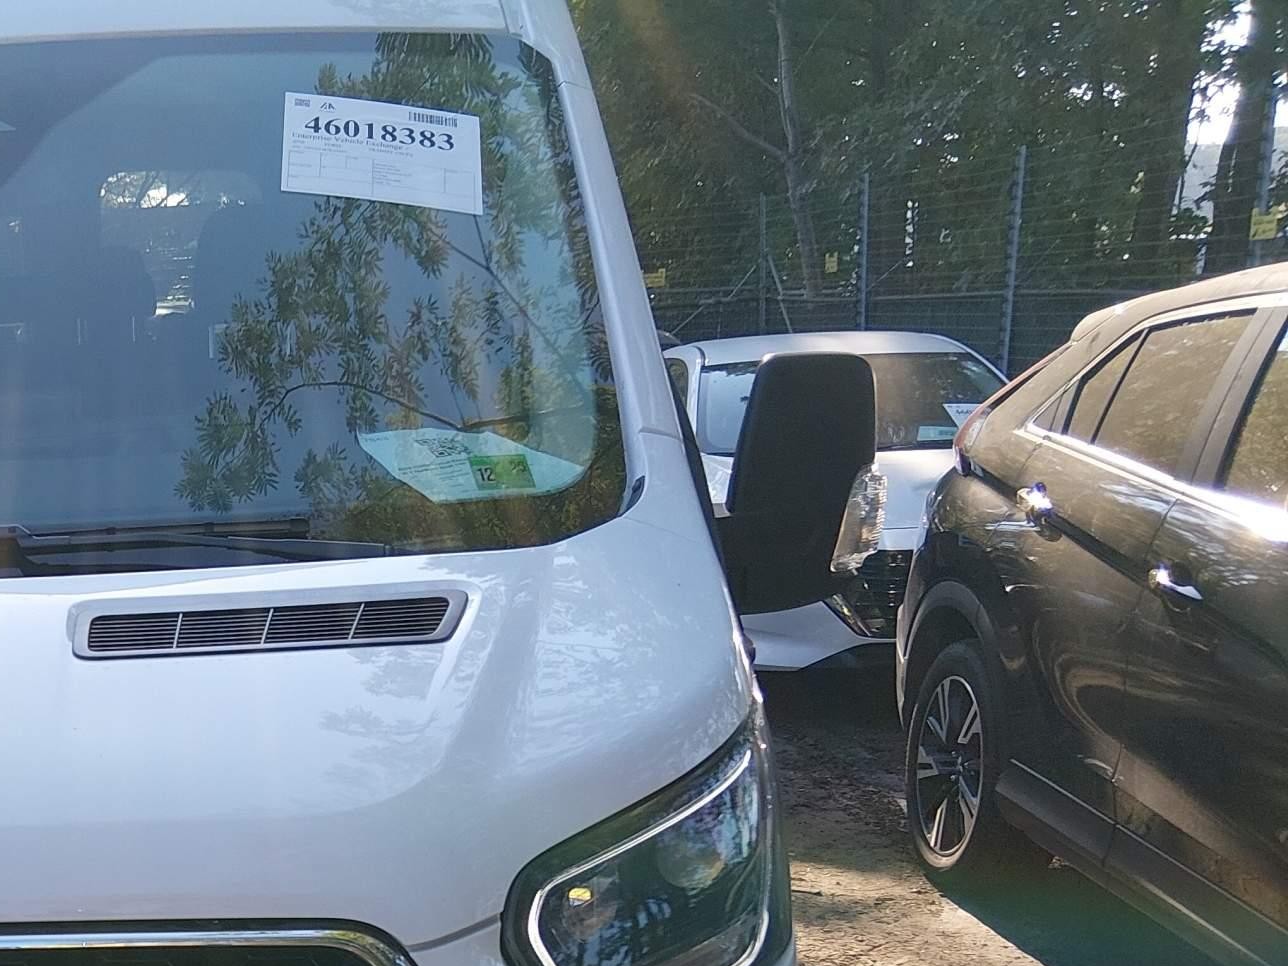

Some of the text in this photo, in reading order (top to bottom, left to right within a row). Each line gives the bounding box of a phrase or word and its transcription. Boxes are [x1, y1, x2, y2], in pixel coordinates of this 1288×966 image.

[292, 131, 332, 141] Enterprise
[365, 140, 404, 151] Exchange
[304, 116, 455, 151] 46018383
[477, 467, 496, 482] 12
